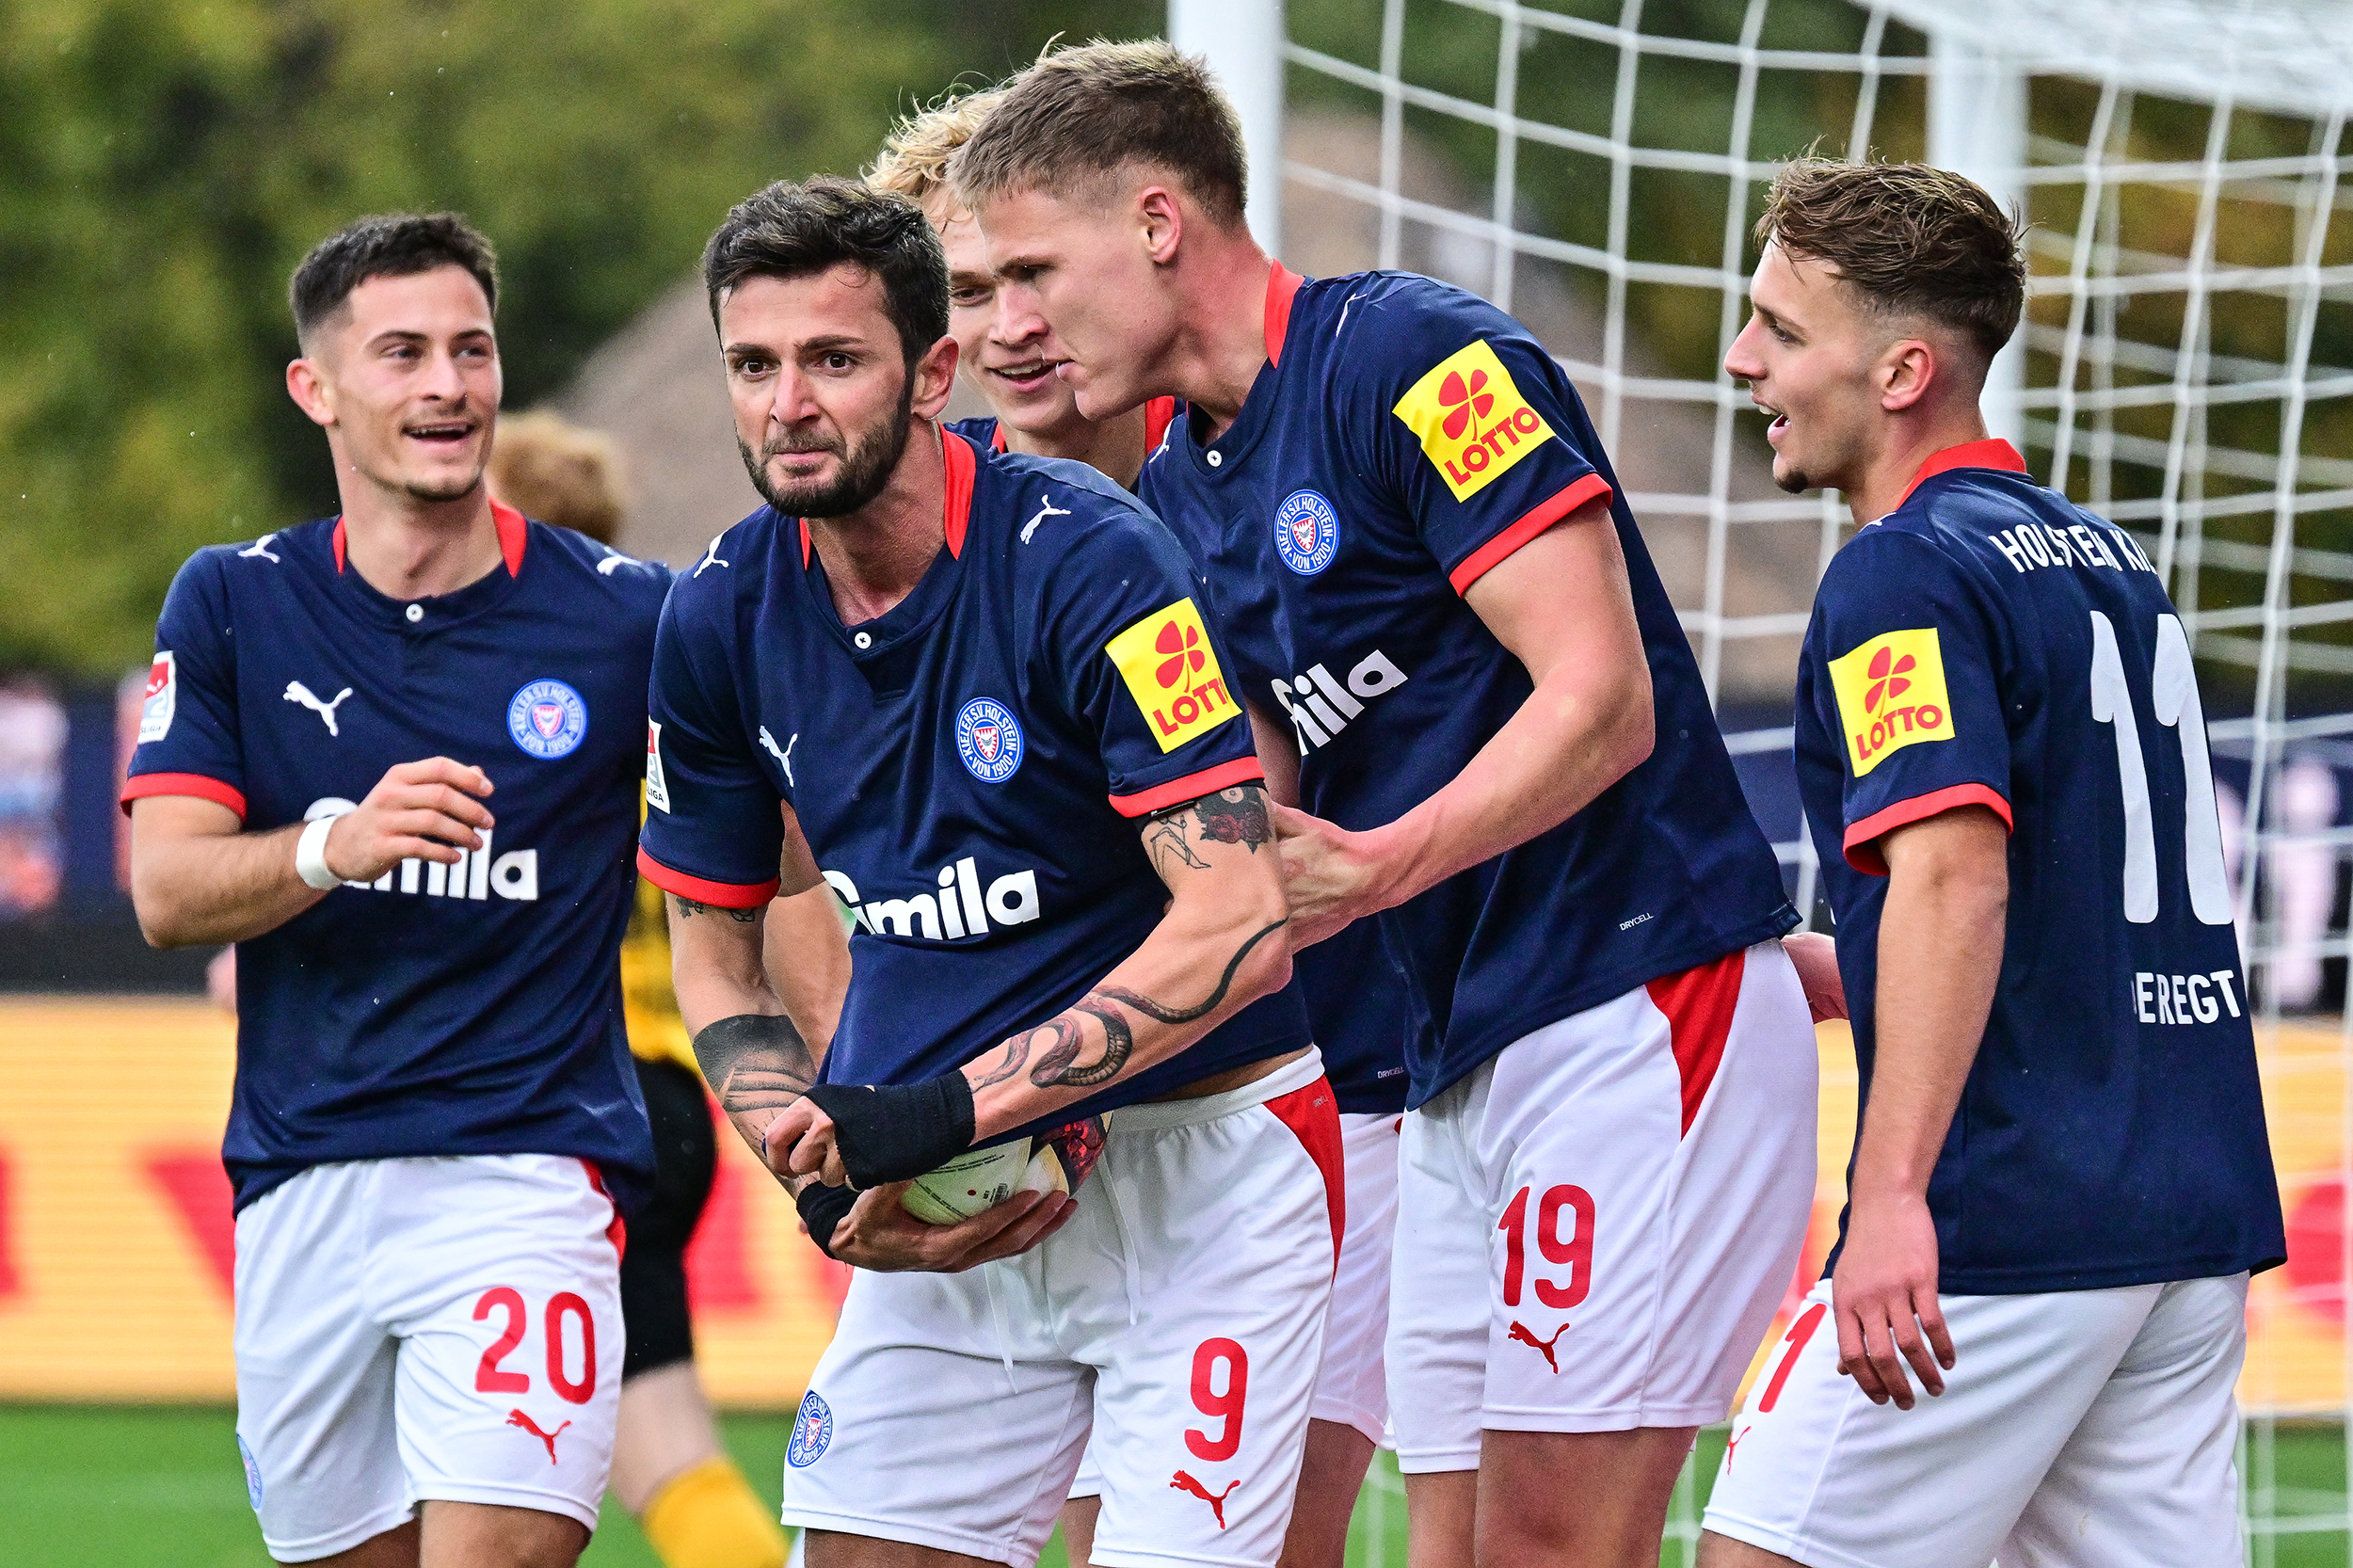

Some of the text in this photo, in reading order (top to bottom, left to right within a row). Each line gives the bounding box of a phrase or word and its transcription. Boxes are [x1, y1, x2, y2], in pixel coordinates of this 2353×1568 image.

[1444, 407, 1540, 486] LOTTO
[1278, 511, 1292, 555] KIELER
[1301, 497, 1334, 537] HOLSTEIN
[1291, 542, 1332, 570] VON 1900
[959, 713, 975, 757] KIELER
[984, 704, 1017, 751] HOLSTEIN
[1152, 677, 1229, 737] LOTT
[1855, 704, 1944, 760] LOTTO
[971, 754, 1014, 777] VON 1900
[2090, 609, 2234, 925] 11
[821, 856, 1040, 940] mila
[1619, 912, 1655, 931] DRYCELL
[2130, 969, 2241, 1025] EREGT
[1497, 1183, 1596, 1309] 19
[472, 1286, 598, 1406] 20
[1184, 1337, 1249, 1463] 9
